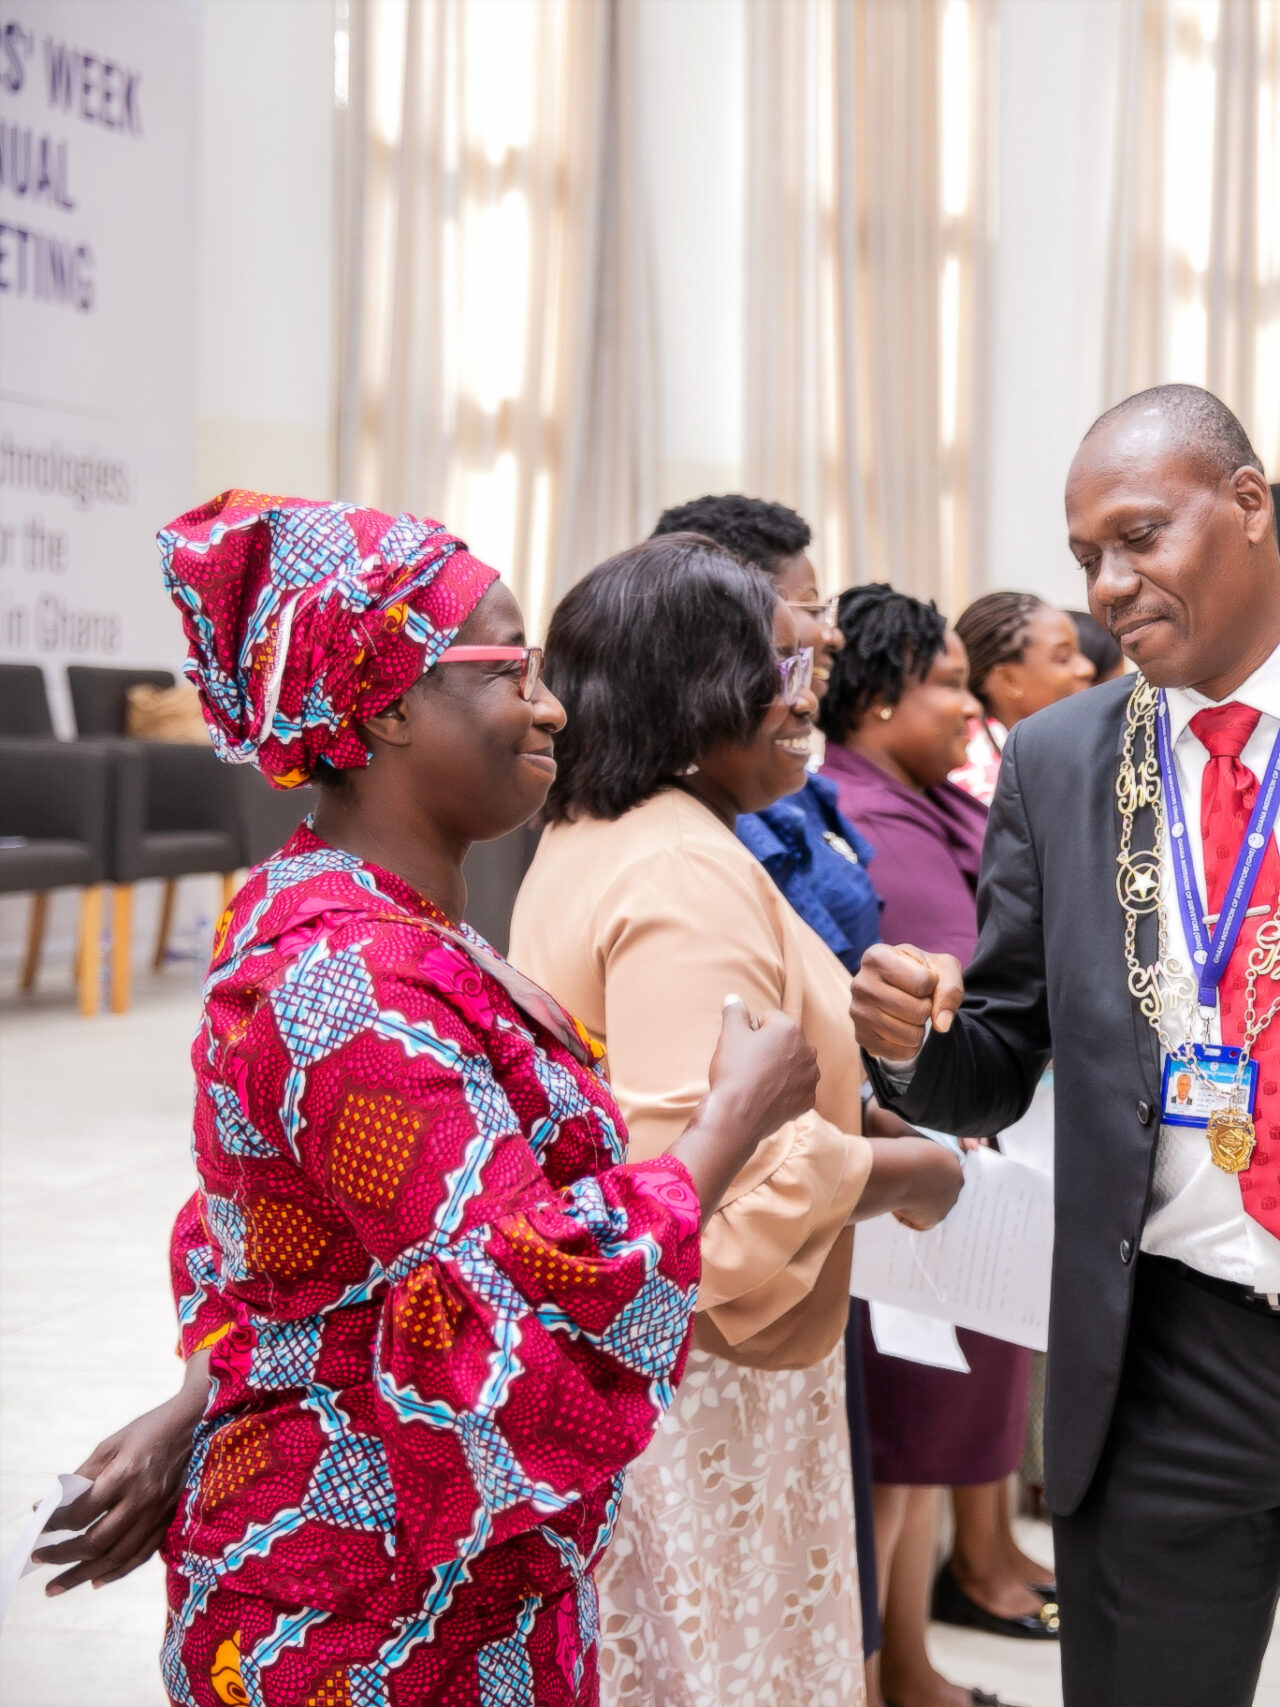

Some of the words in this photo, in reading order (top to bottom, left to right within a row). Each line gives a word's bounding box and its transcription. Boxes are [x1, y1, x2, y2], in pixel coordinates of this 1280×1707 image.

[42, 33, 143, 138] WEEK
[1255, 810, 1267, 833] GHANA
[1213, 941, 1225, 964] GHANA
